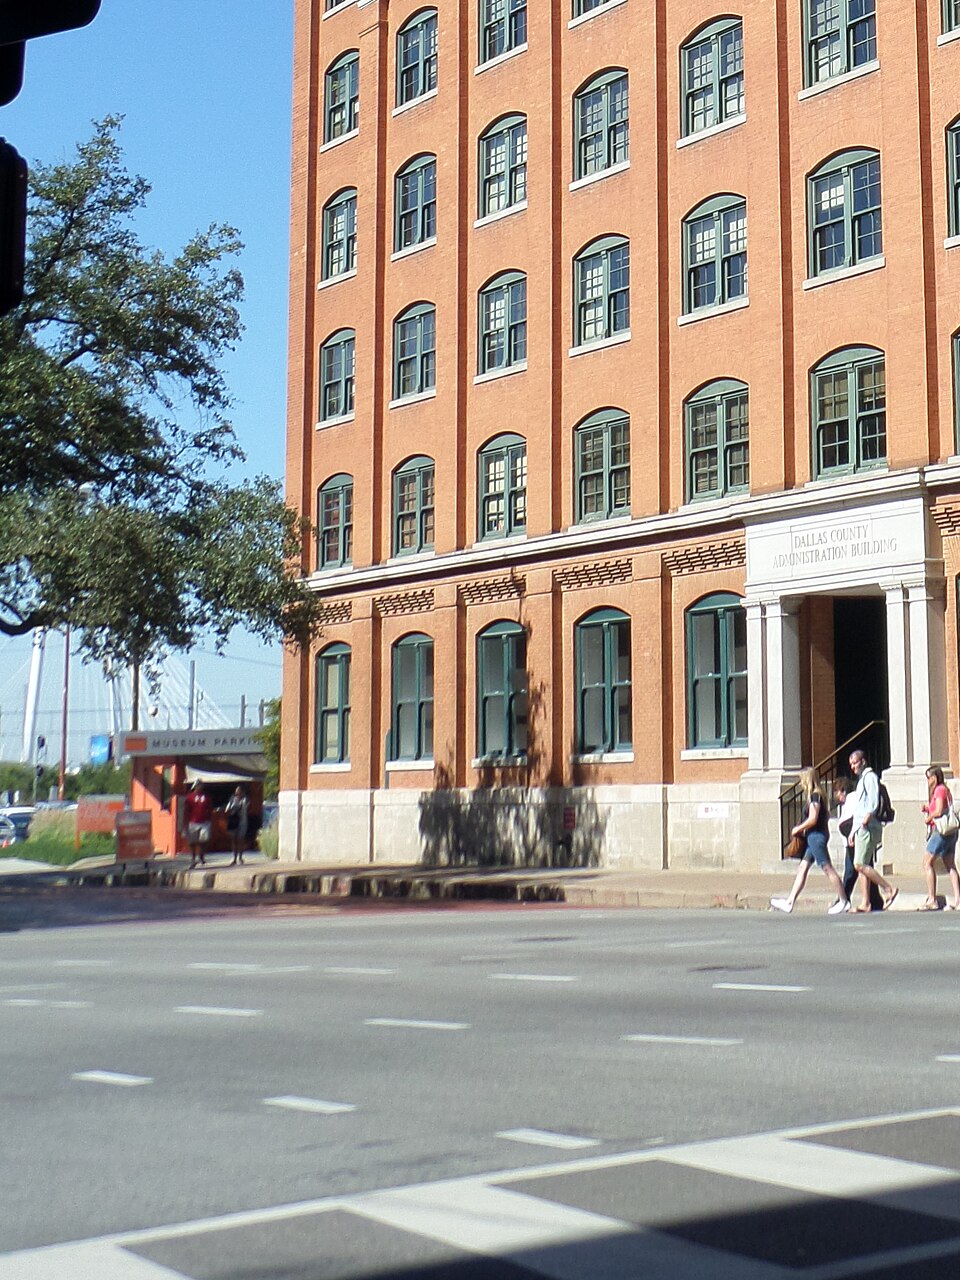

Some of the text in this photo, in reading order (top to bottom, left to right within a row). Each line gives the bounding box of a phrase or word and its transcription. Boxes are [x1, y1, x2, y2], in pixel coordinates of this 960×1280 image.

[794, 525, 868, 549] DALLAS COUNTY
[773, 538, 897, 568] ADMINISTRATION BUILDING
[152, 738, 206, 748] MUSEUM
